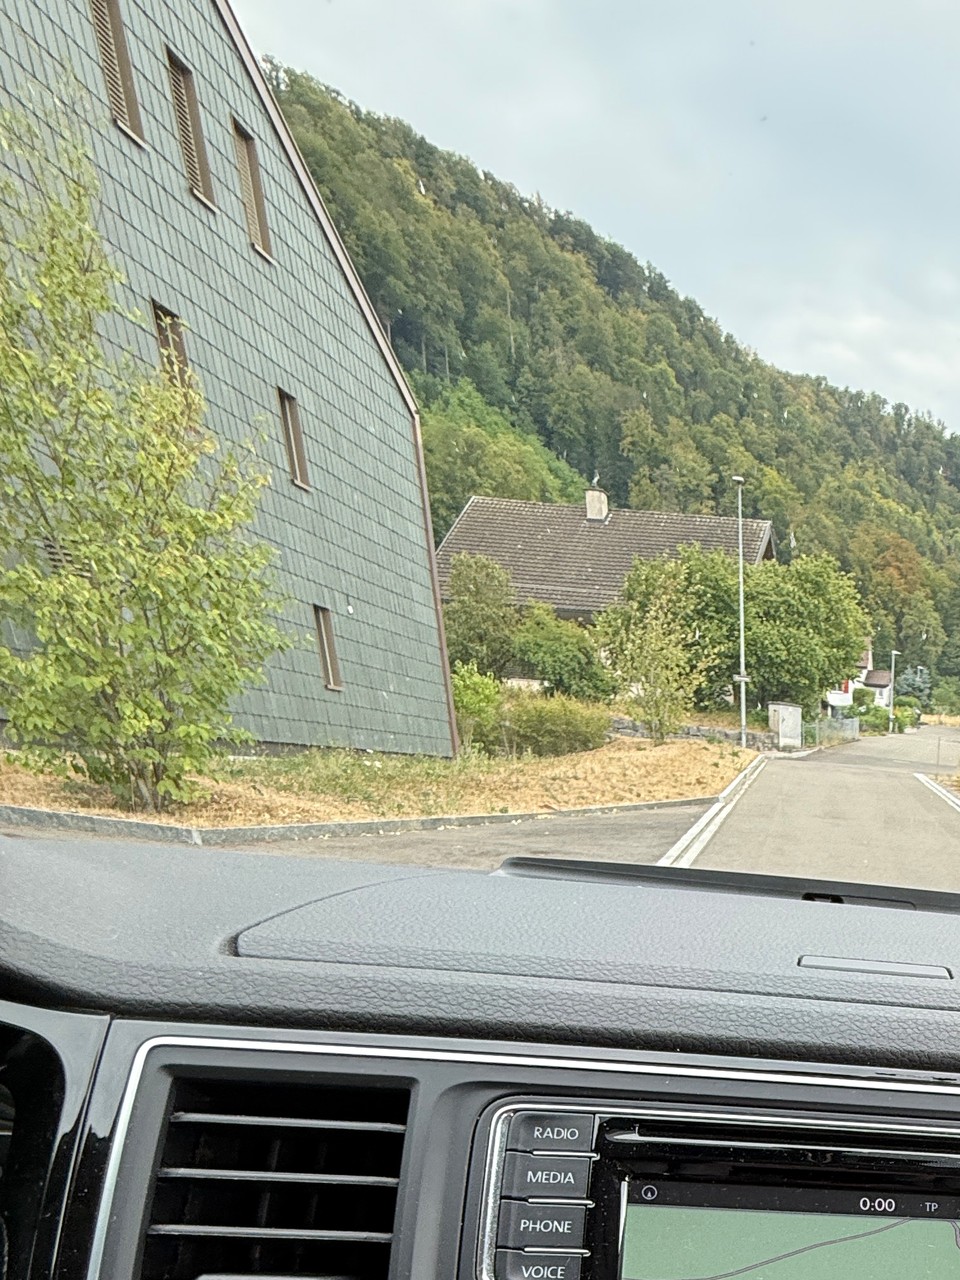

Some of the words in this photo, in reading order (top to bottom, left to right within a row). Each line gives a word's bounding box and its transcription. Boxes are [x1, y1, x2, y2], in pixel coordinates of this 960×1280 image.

[533, 1126, 579, 1140] RADIO
[526, 1170, 575, 1184] MEDIA
[859, 1197, 896, 1212] 0:00
[924, 1202, 939, 1212] TP
[519, 1219, 572, 1233] PHONE
[521, 1266, 565, 1279] VOICE
